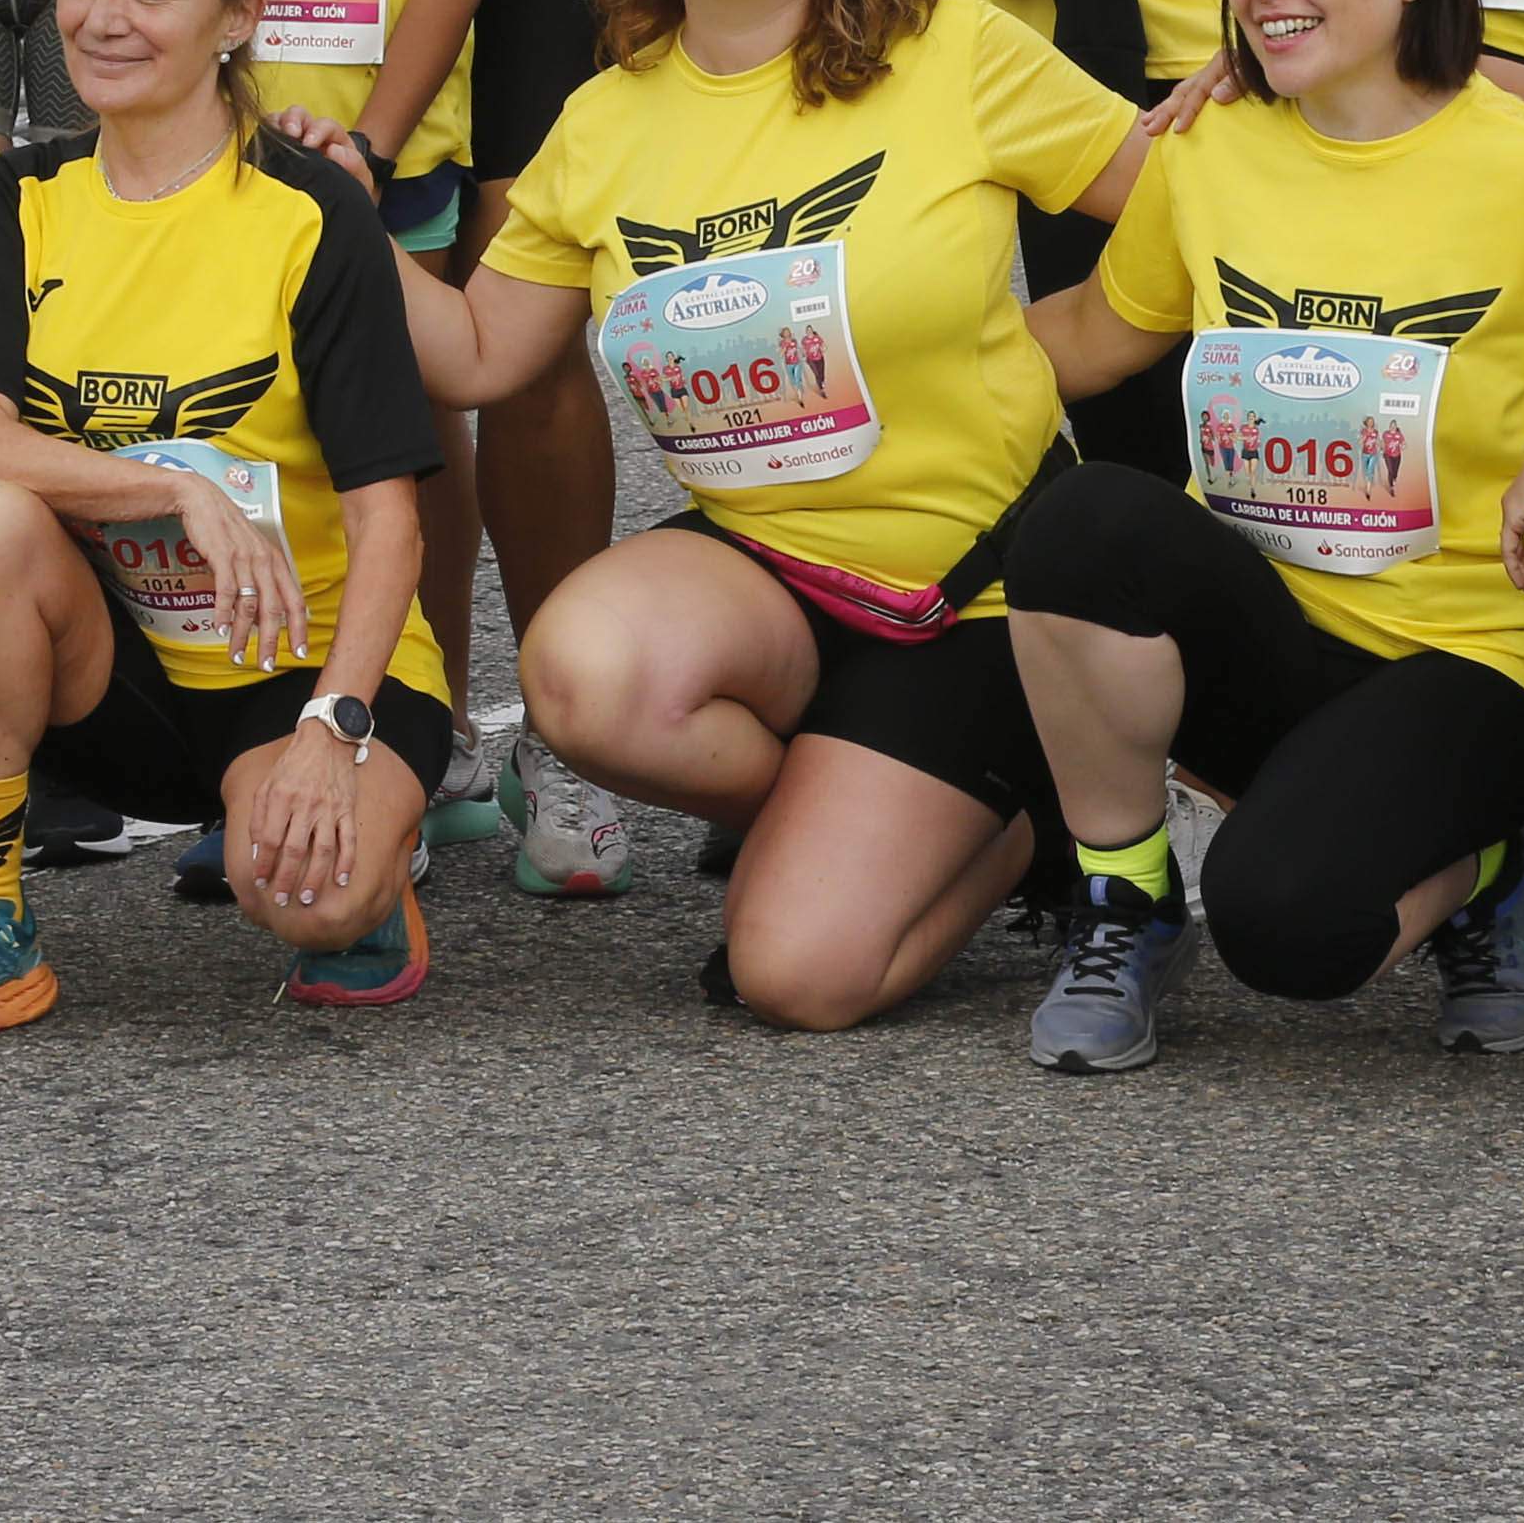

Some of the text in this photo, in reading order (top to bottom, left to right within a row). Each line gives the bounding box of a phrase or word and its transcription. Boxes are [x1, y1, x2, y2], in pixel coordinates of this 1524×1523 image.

[312, 5, 346, 19] GIJÓN
[284, 33, 355, 49] Santander
[701, 207, 773, 245] BORN
[792, 260, 815, 277] 20
[614, 300, 648, 317] SUMA
[672, 291, 762, 322] ASTURIANA
[1300, 298, 1374, 327] BORN
[1201, 352, 1240, 366] SUMA
[1388, 354, 1414, 371] 20
[691, 357, 781, 405] 016
[1261, 364, 1353, 388] ASTURIANA
[82, 377, 160, 407] BORN
[723, 409, 763, 428] 1021
[674, 415, 835, 451] CARRERA DE LA MUJER GIJÓN
[784, 443, 855, 469] Santander
[1264, 437, 1353, 478] 016
[229, 468, 249, 484] 20
[680, 460, 742, 476] OYSHO
[1286, 487, 1327, 505] 1018
[1231, 502, 1397, 527] CARRERA DE LA MUJER GIJÓN
[112, 538, 207, 569] 016
[1334, 543, 1411, 559] Santander
[143, 578, 186, 592] 1014
[139, 593, 215, 606] DE LA MUJER
